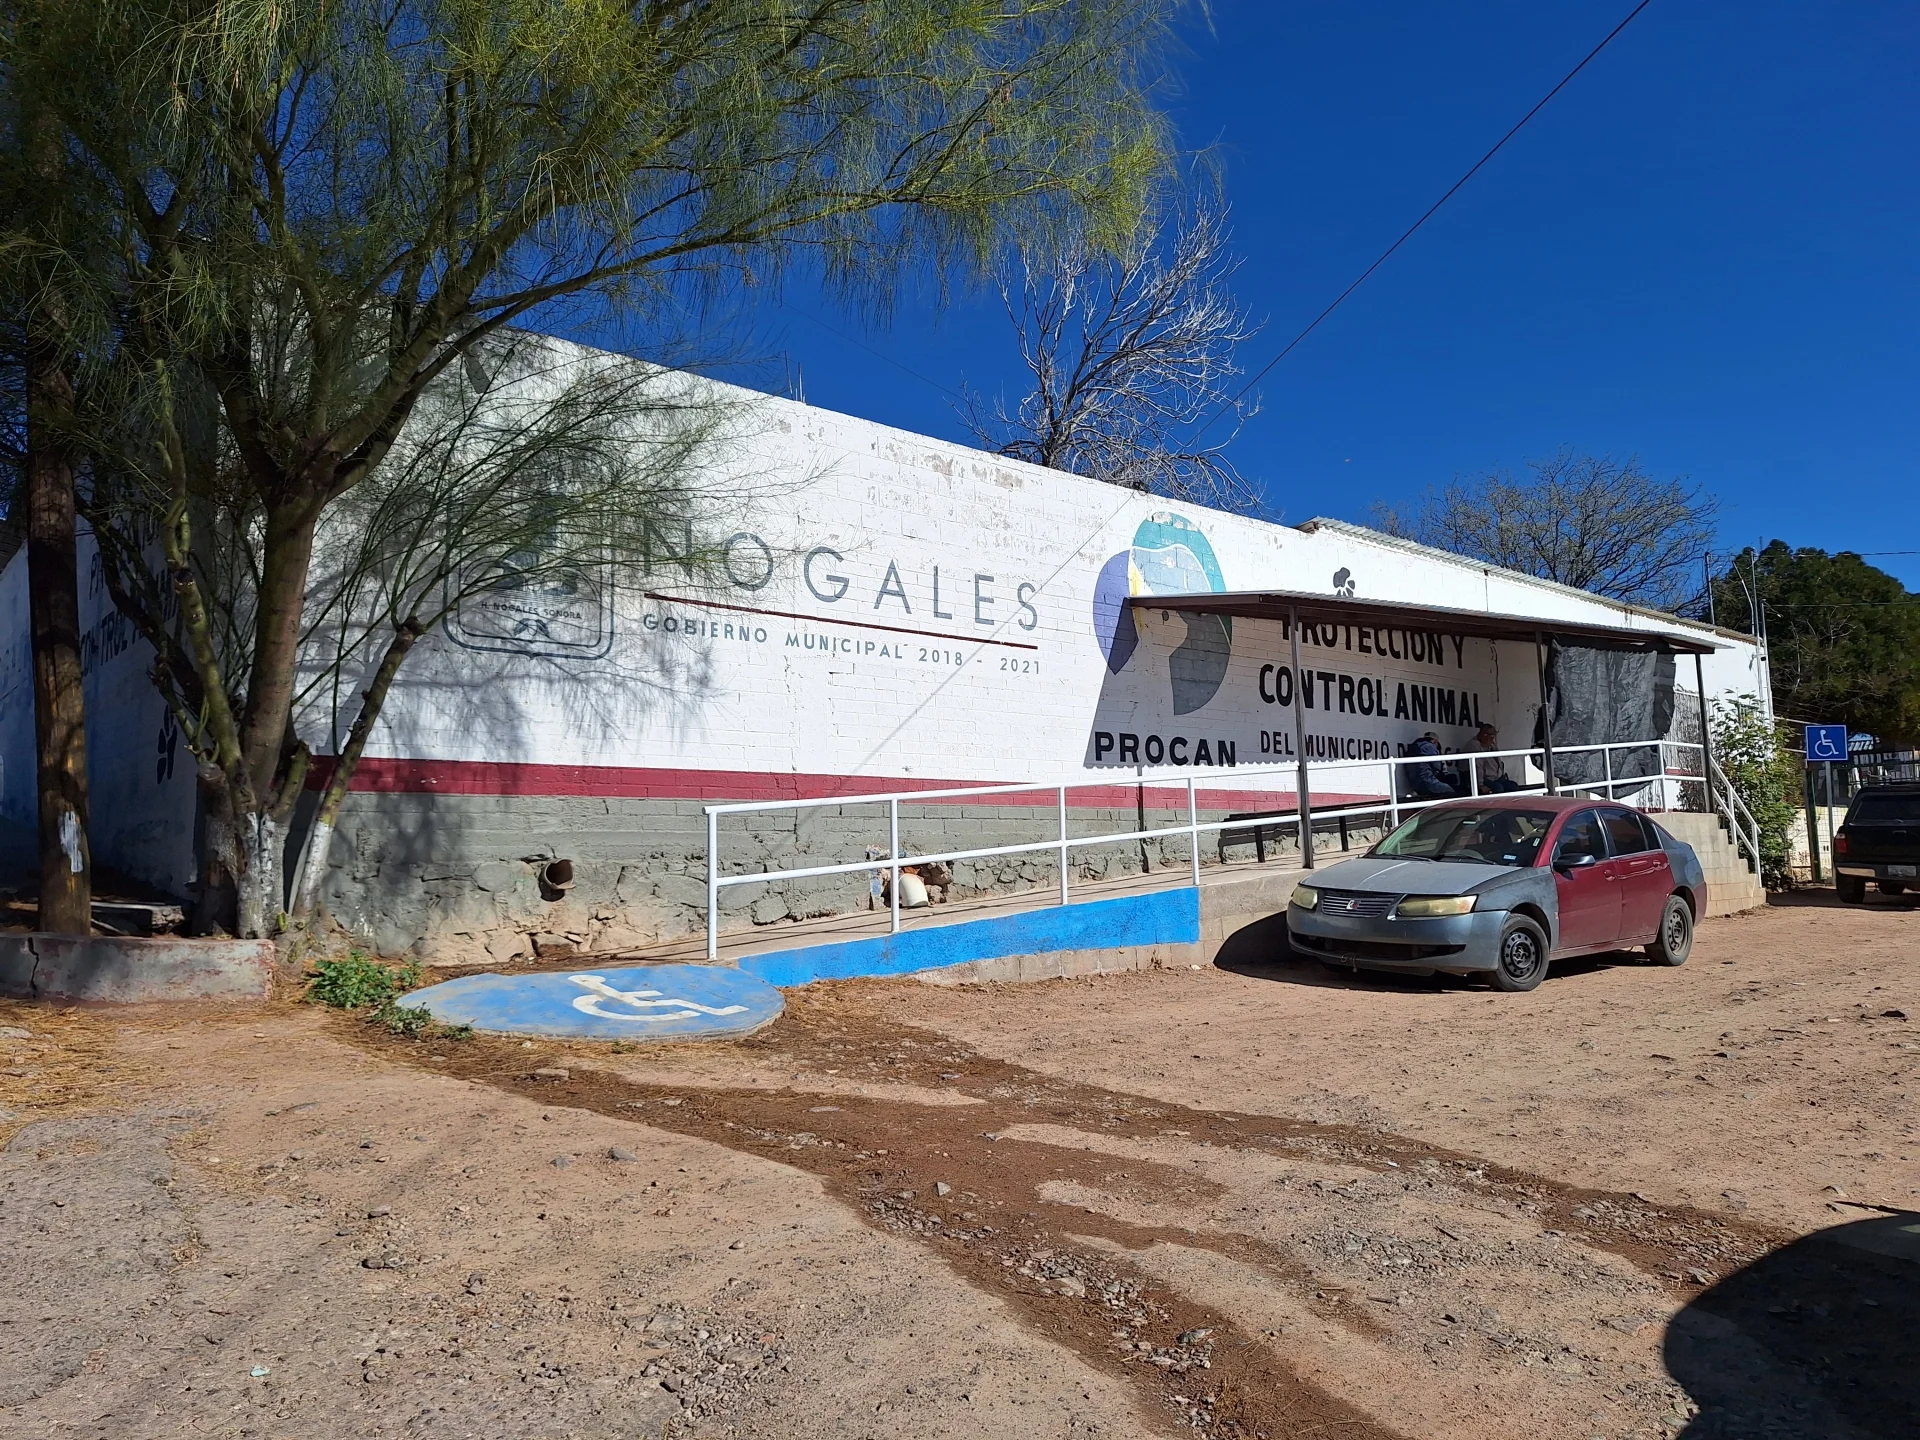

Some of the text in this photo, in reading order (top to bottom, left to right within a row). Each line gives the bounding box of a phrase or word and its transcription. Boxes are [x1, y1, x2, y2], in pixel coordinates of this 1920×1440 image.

[644, 520, 1039, 631] NOGALES
[493, 602, 538, 615] NOGALES
[543, 608, 582, 619] SONORA
[643, 613, 768, 643] GOBIERNO
[785, 632, 903, 660] MUNICIPAL
[918, 648, 963, 666] 2018
[1000, 657, 1041, 675] 2021
[1450, 634, 1464, 669] Y
[1259, 663, 1484, 729] CONTROL ANIMAL
[1094, 731, 1236, 767] PROCAN
[1260, 730, 1295, 756] DEL
[1304, 734, 1390, 761] MUNICIPIO
